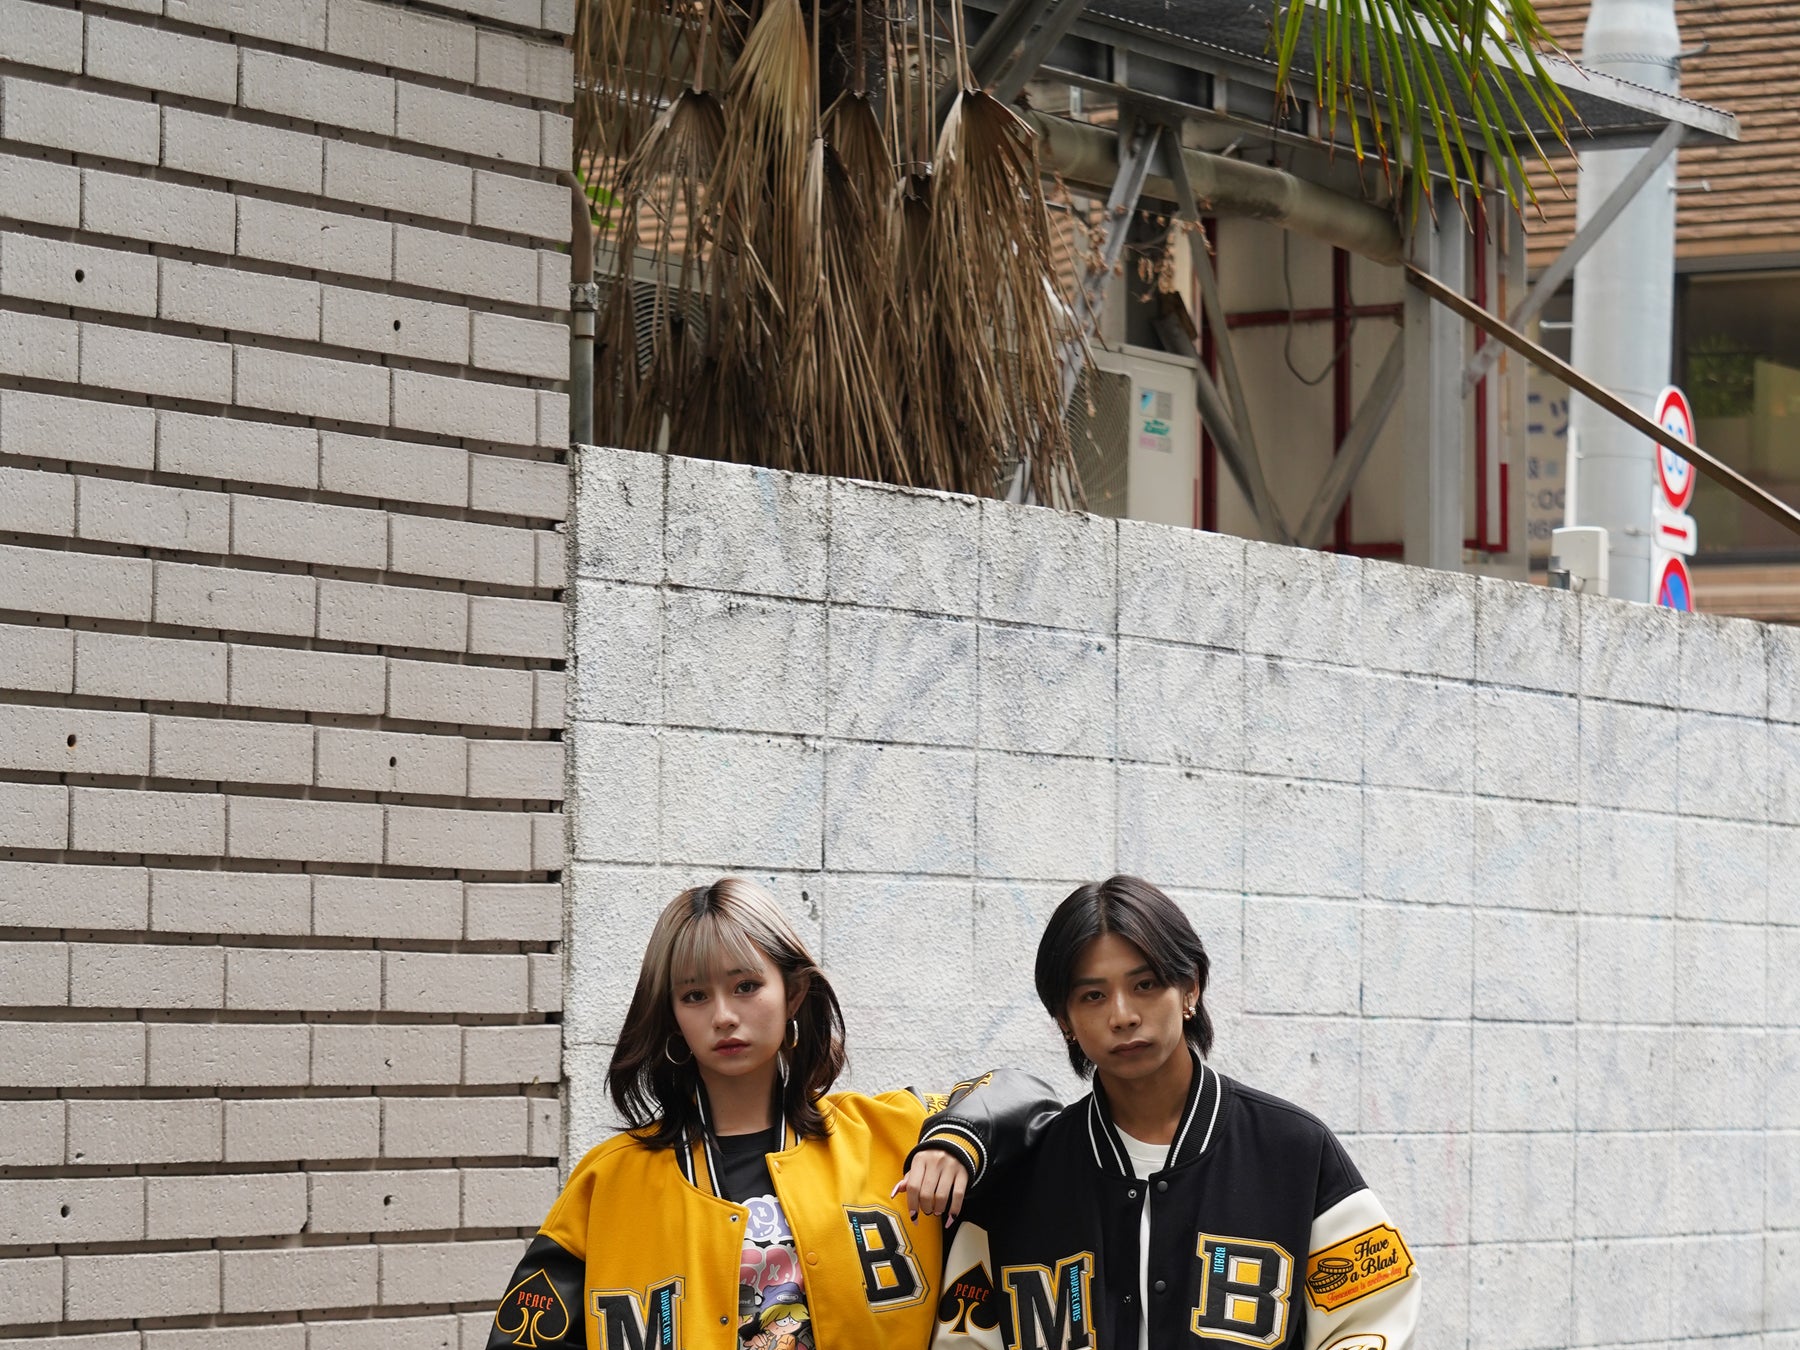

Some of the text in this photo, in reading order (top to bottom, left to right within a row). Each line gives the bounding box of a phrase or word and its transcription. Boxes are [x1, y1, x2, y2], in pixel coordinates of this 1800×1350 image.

[845, 1208, 926, 1309] B
[1354, 1237, 1389, 1261] Have
[1350, 1248, 1398, 1283] a Blast
[517, 1290, 553, 1311] PEACE
[954, 1283, 989, 1301] PEACE
[1194, 1236, 1290, 1346] B
